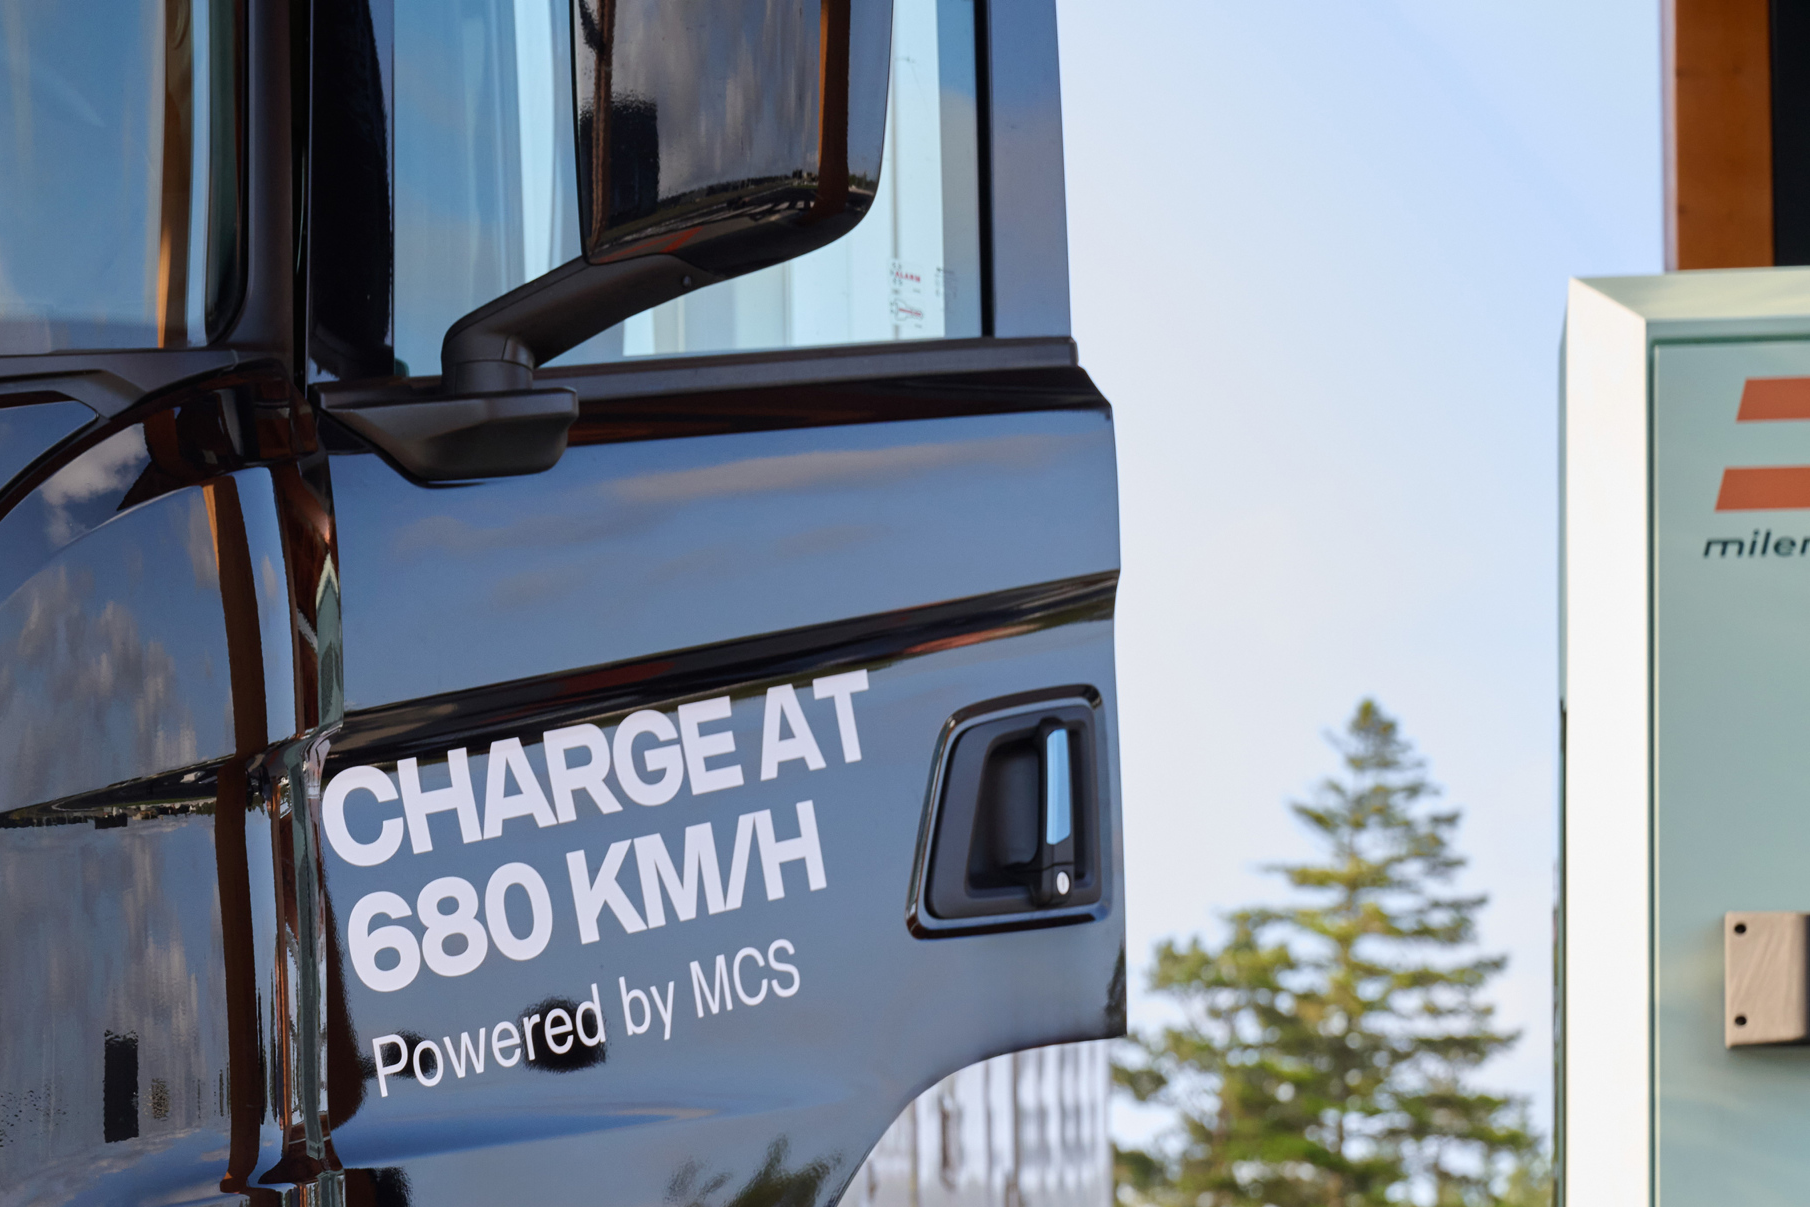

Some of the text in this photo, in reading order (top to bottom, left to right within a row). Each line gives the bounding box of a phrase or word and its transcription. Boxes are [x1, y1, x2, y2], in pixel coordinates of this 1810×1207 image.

[322, 669, 869, 867] CHARGE AT
[347, 799, 827, 993] 680 KM/H
[372, 938, 801, 1098] Powered by MCS
